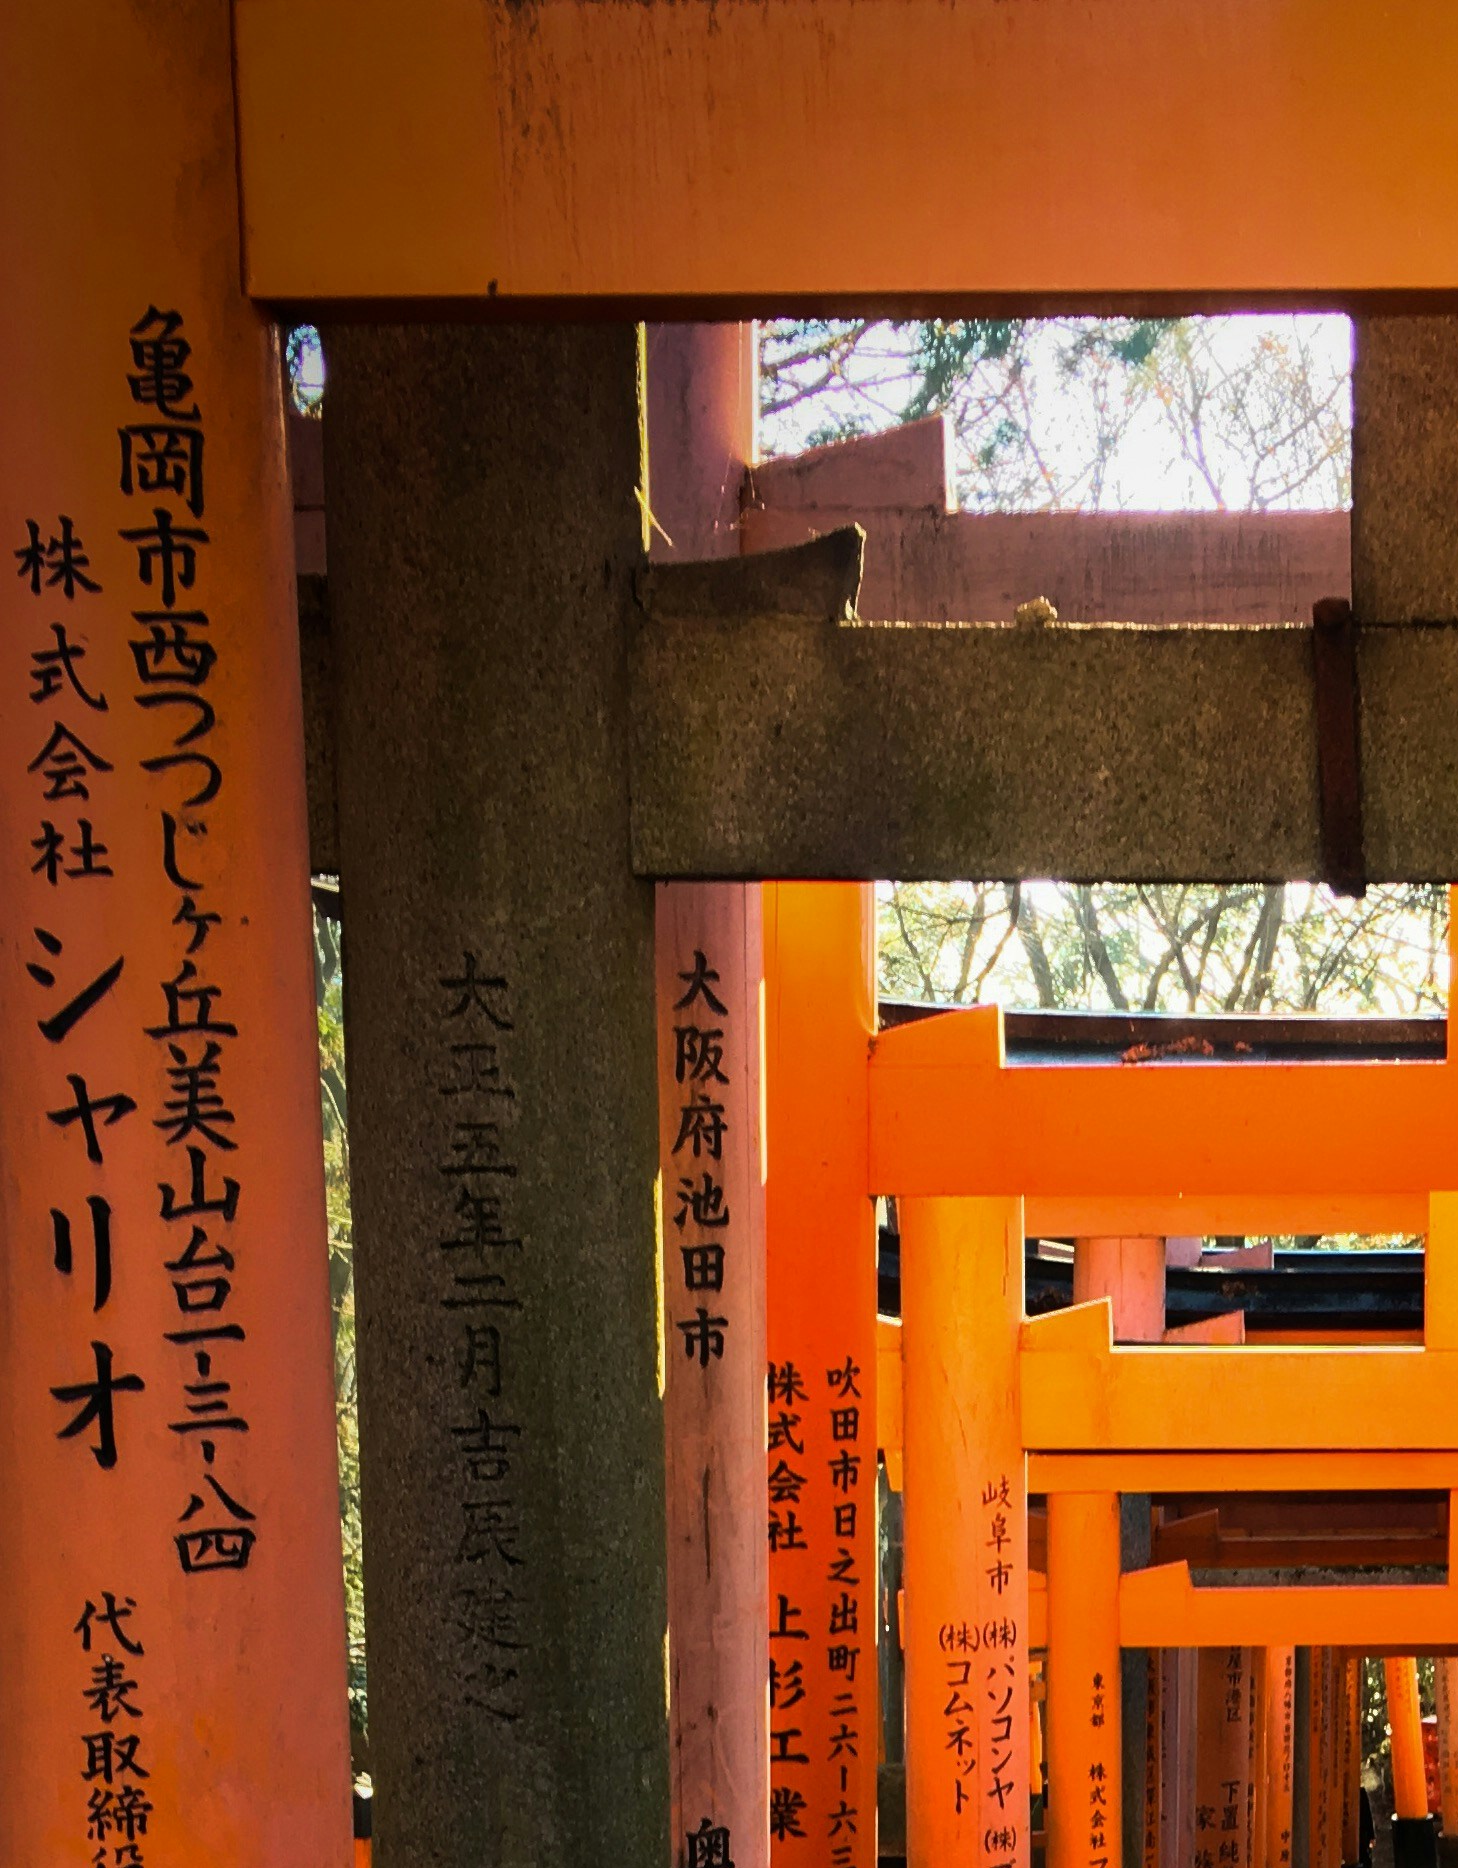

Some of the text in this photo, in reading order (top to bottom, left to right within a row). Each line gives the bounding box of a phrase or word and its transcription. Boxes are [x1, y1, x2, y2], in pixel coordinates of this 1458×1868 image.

[671, 950, 730, 1369] 大阪府池田市
